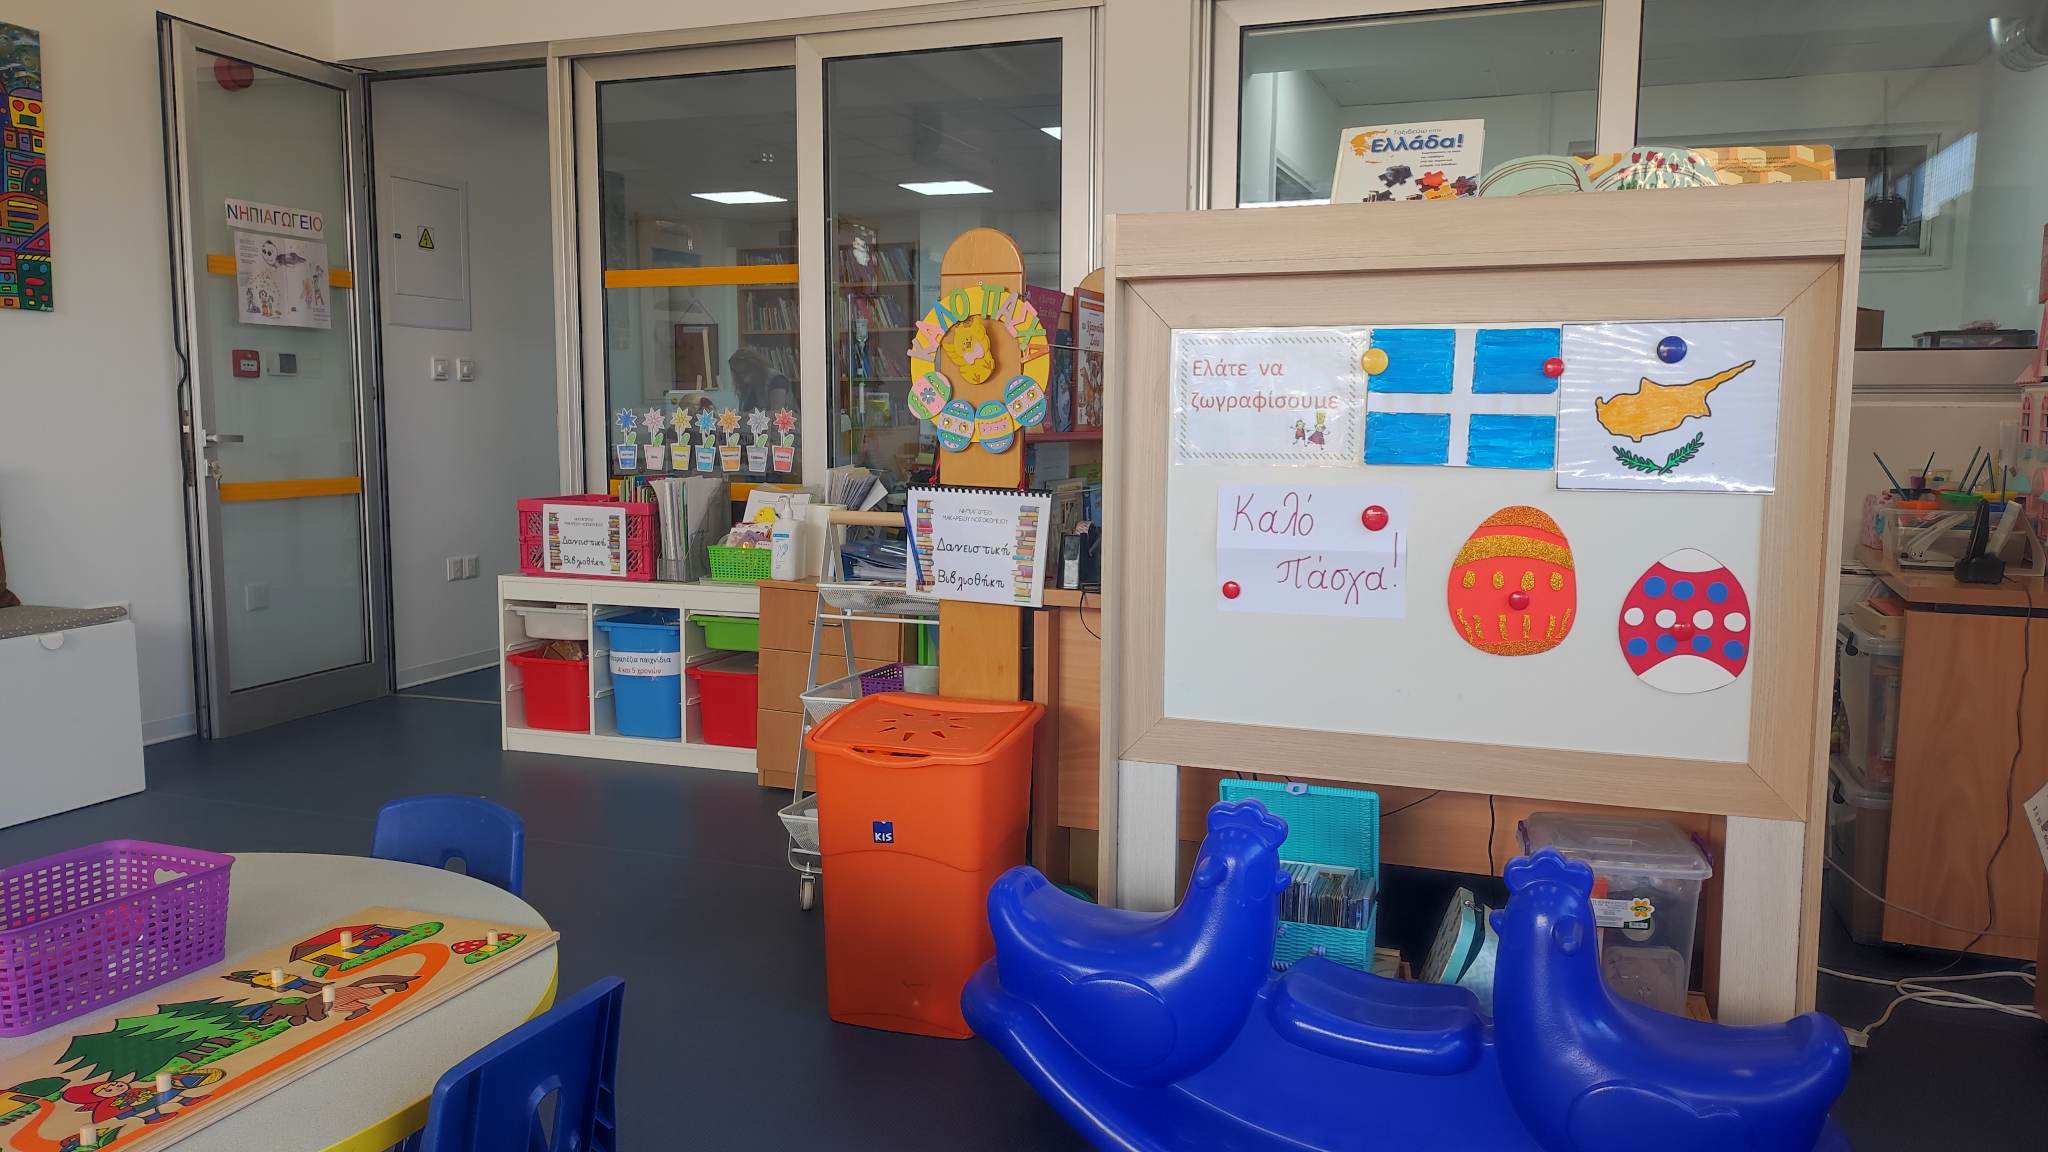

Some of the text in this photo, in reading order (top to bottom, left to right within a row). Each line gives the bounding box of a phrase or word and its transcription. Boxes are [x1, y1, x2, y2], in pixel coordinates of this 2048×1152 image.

[1371, 133, 1464, 153] Ελλάδα!
[226, 203, 323, 232] ΝΗΠΙΑΓΩΓΕΙΟ
[1192, 358, 1284, 377] Ελάτε να
[1190, 390, 1339, 412] ζωγραφίσουμε
[1233, 492, 1314, 537] Καλό
[937, 537, 1011, 556] Δανειστική
[1276, 532, 1398, 605] Πάσχα!
[938, 569, 1005, 591] Βιβλιοθήκη
[874, 832, 892, 841] KIS
